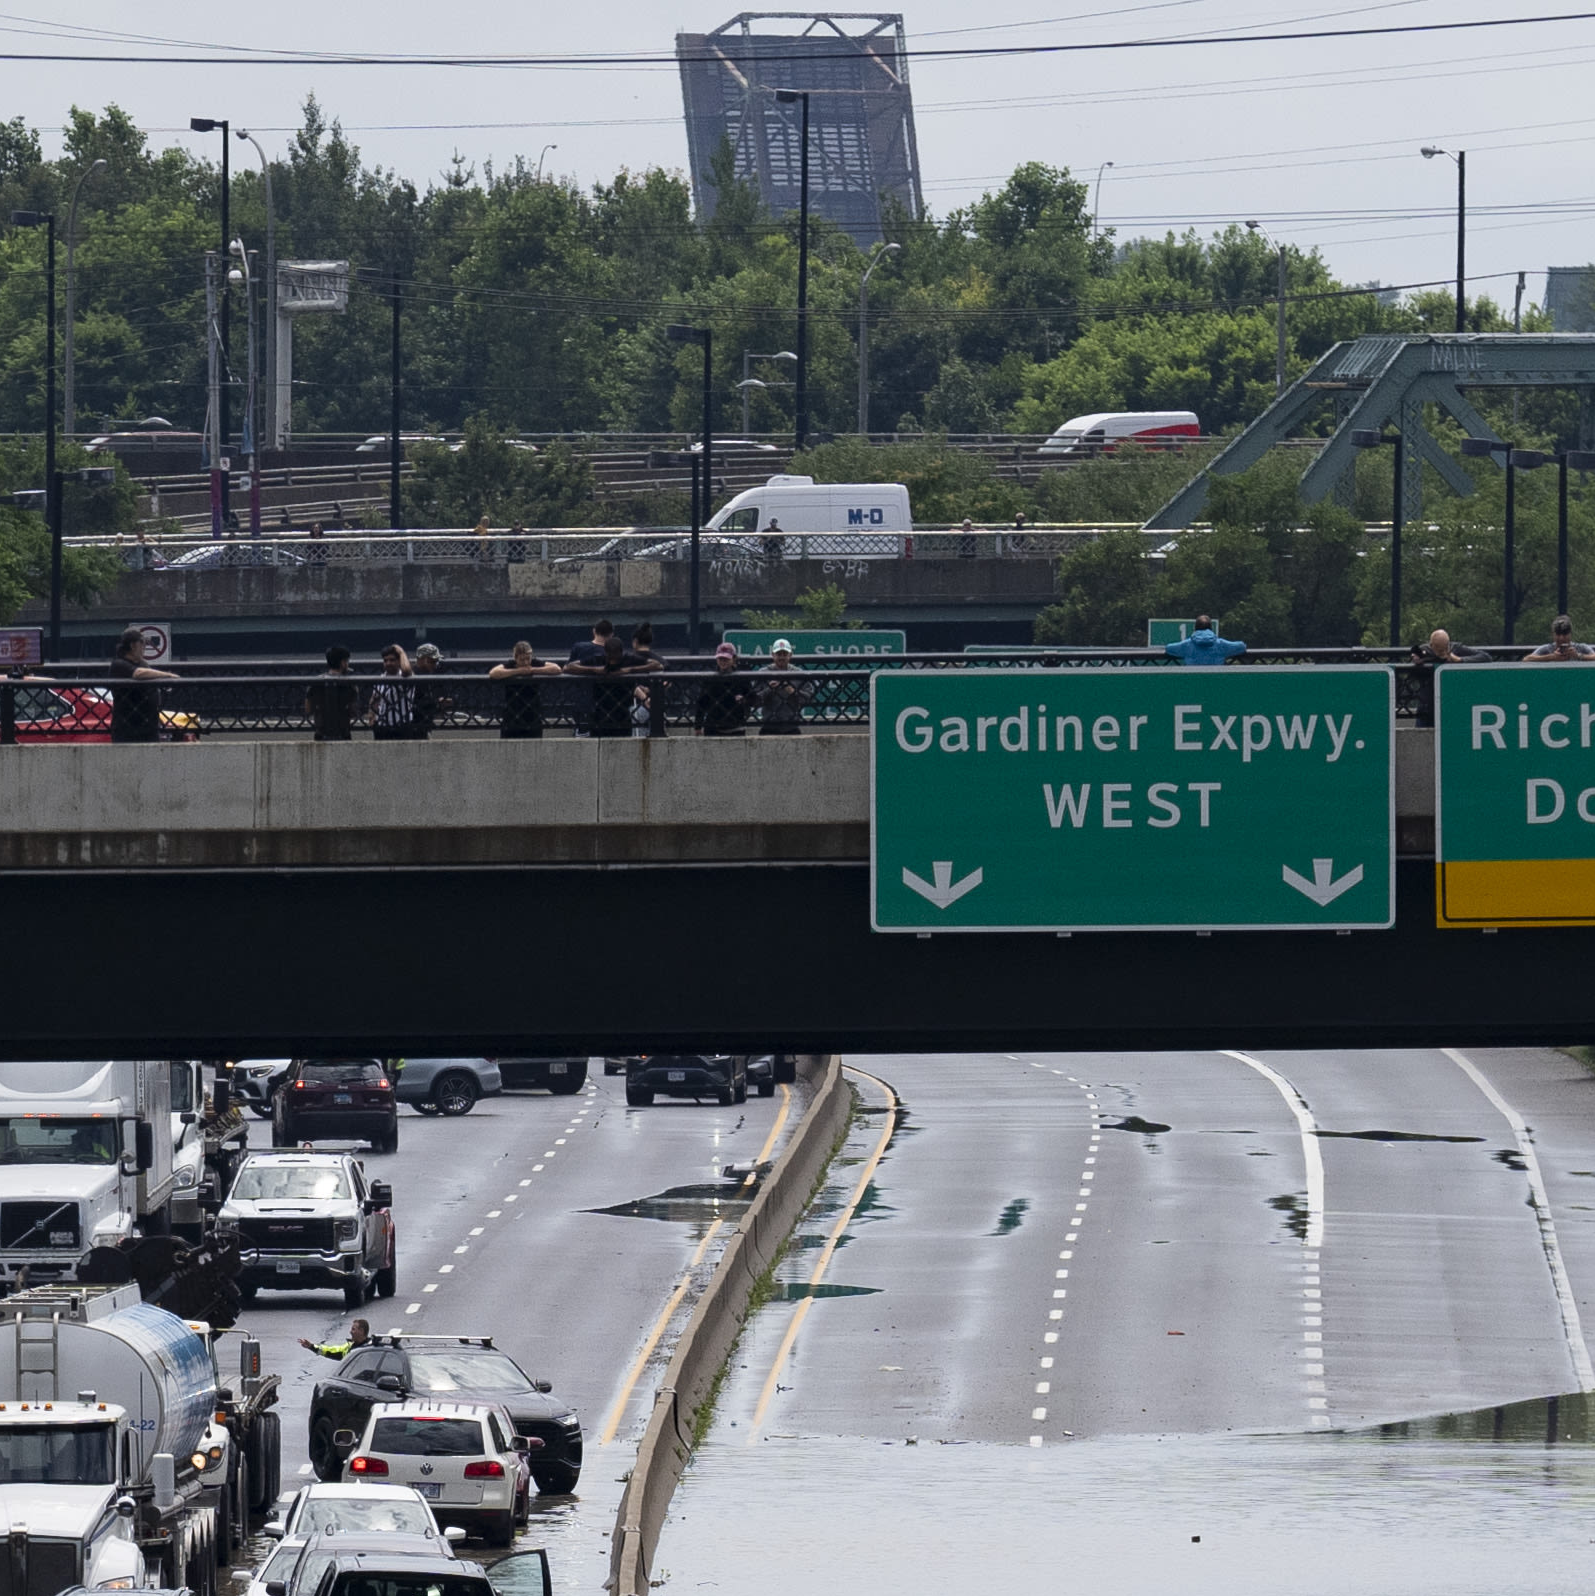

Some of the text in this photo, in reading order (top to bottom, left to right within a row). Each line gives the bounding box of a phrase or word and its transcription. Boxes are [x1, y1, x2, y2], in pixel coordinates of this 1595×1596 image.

[1178, 623, 1188, 641] 1
[895, 703, 1366, 763] Gardiner Expwy.
[1043, 781, 1222, 829] WEST
